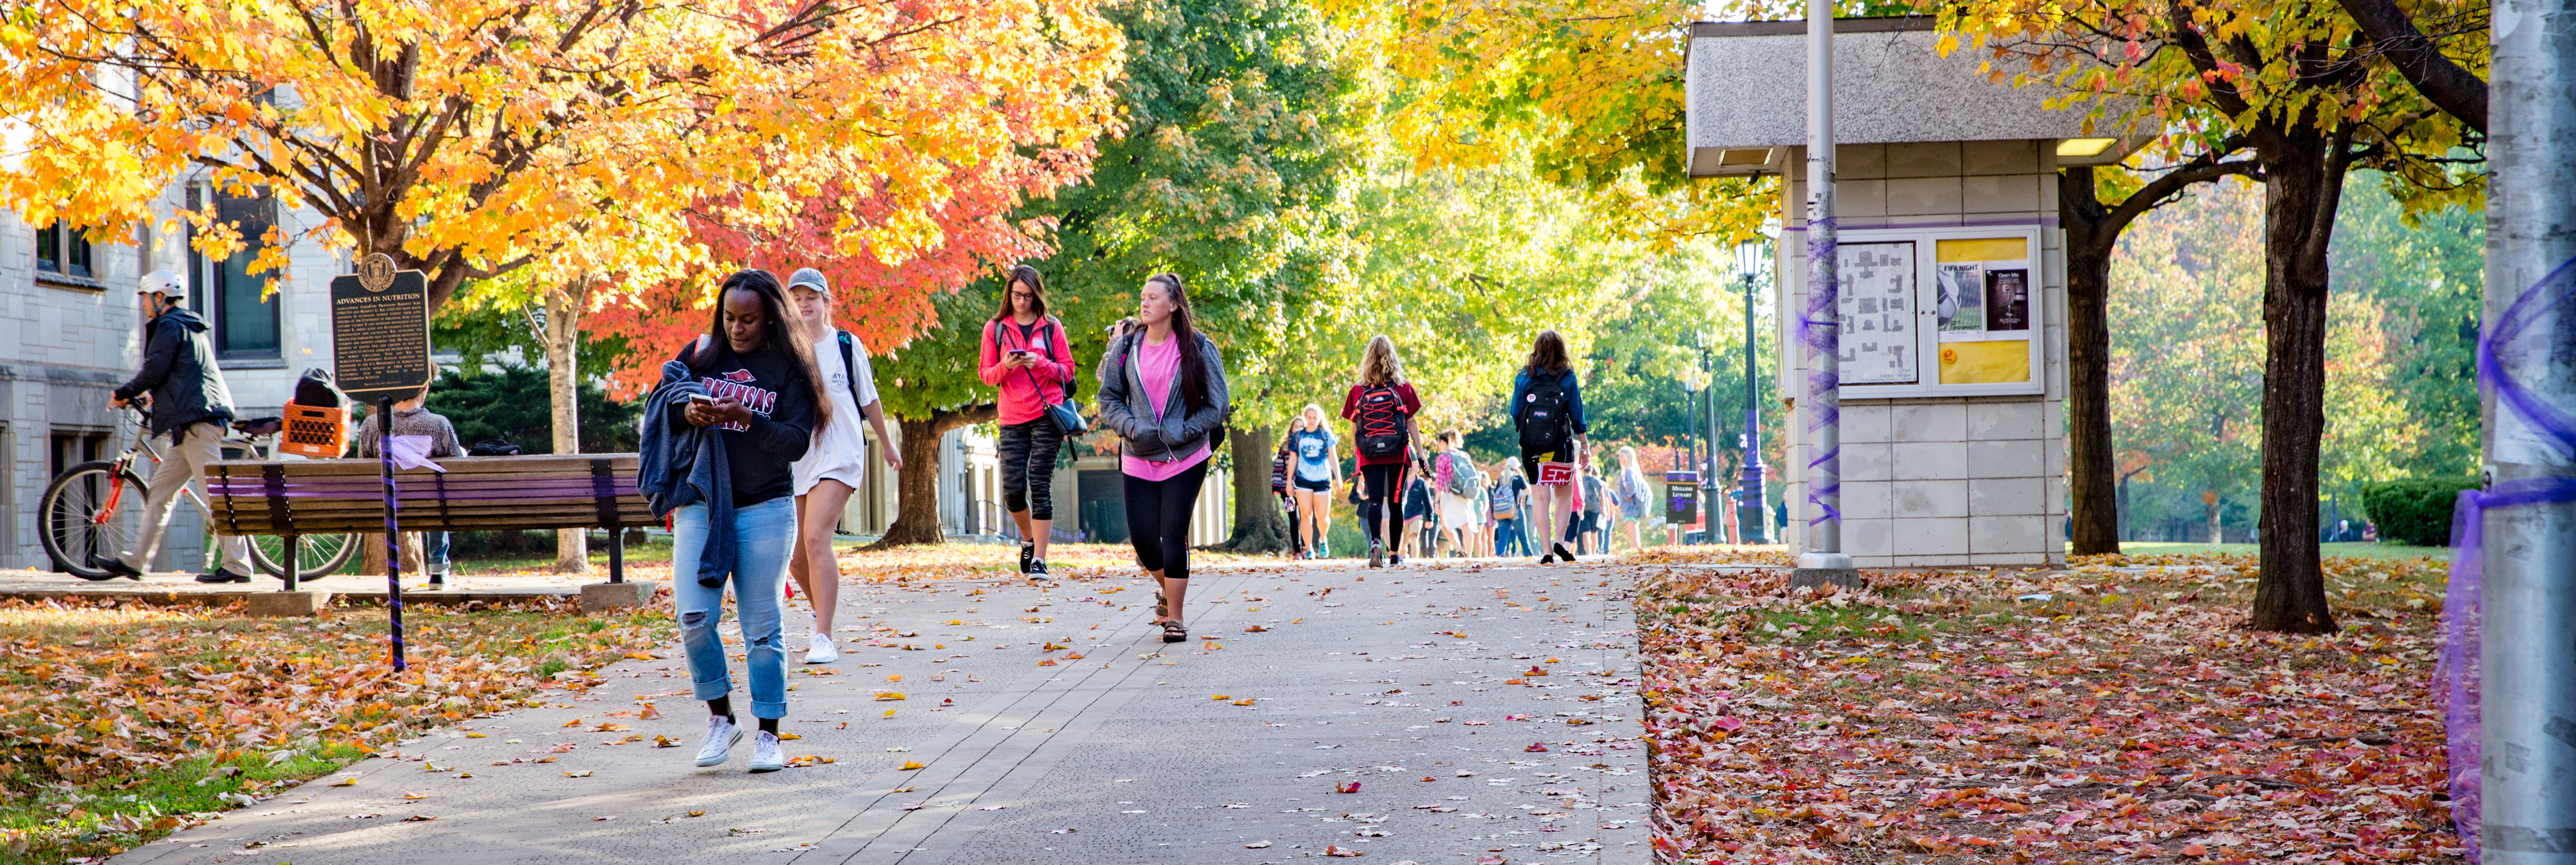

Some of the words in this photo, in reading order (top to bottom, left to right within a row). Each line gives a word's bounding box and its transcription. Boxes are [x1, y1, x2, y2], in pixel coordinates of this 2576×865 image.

[382, 293, 420, 301] NUTRITION
[699, 376, 777, 414] RKANSAS
[1541, 465, 1572, 480] EM
